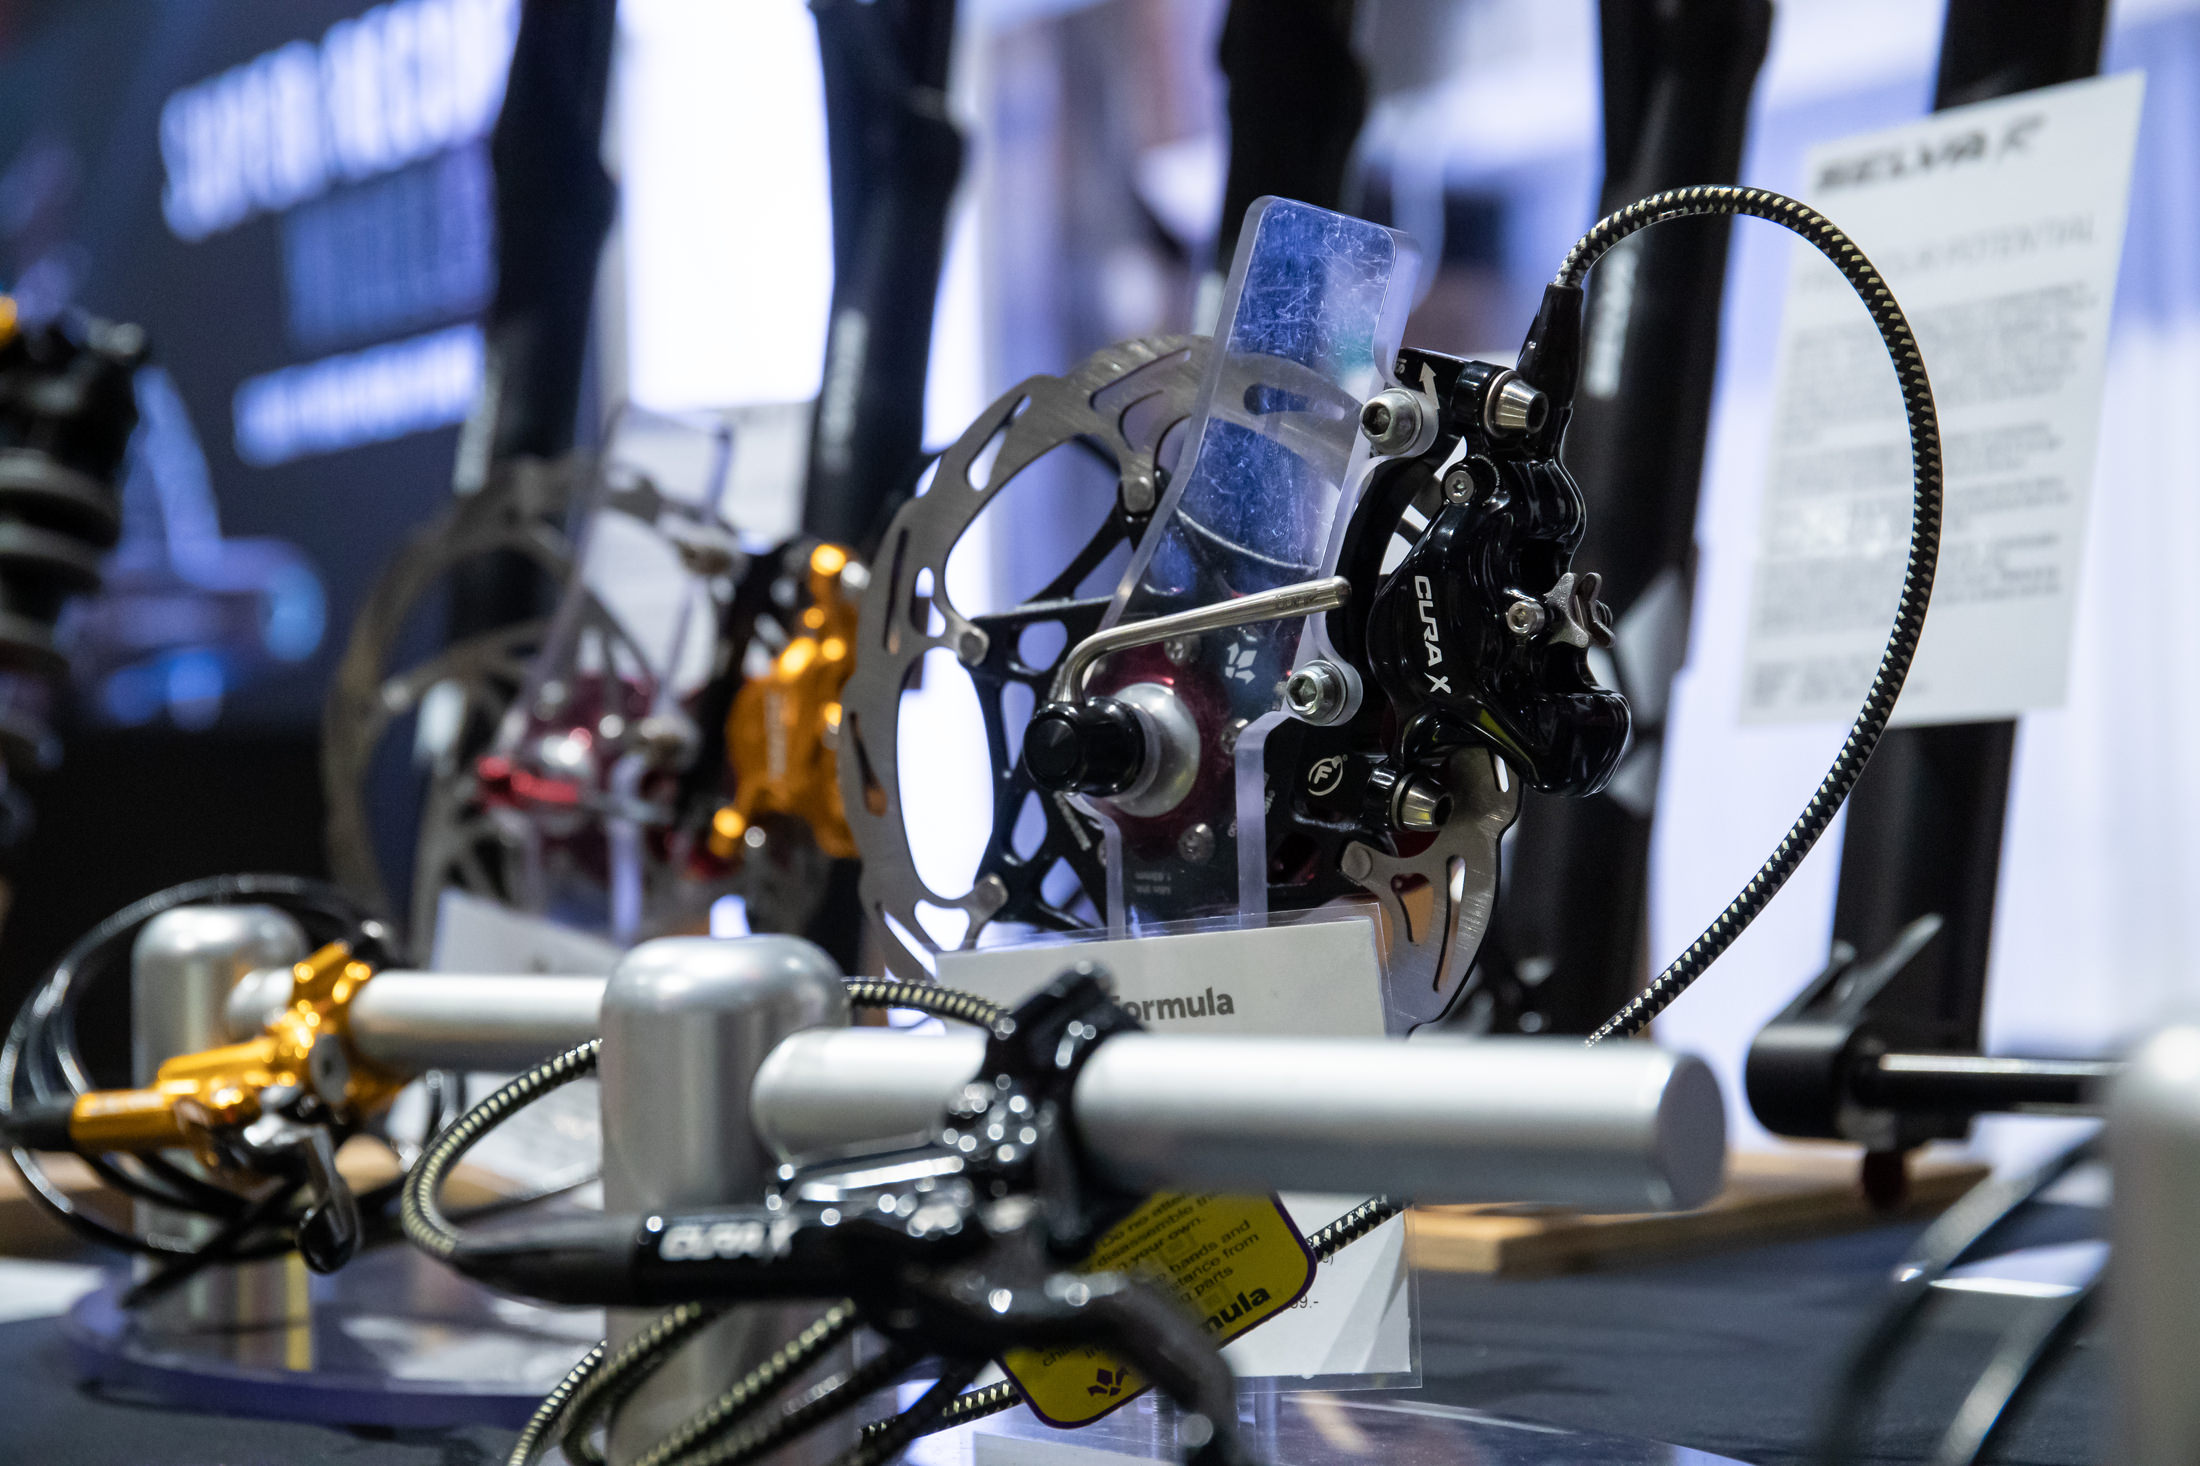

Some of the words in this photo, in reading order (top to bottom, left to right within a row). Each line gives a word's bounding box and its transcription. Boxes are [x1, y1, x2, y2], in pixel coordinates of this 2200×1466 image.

[1414, 575, 1443, 667] CURA
[1423, 671, 1452, 694] X
[1112, 986, 1235, 1021] ormula
[1167, 1257, 1221, 1293] stance
[1222, 1233, 1260, 1259] from
[1169, 1240, 1218, 1273] hands
[1220, 1219, 1250, 1244] and
[1194, 1266, 1234, 1296] parts
[1200, 1287, 1271, 1334] mula
